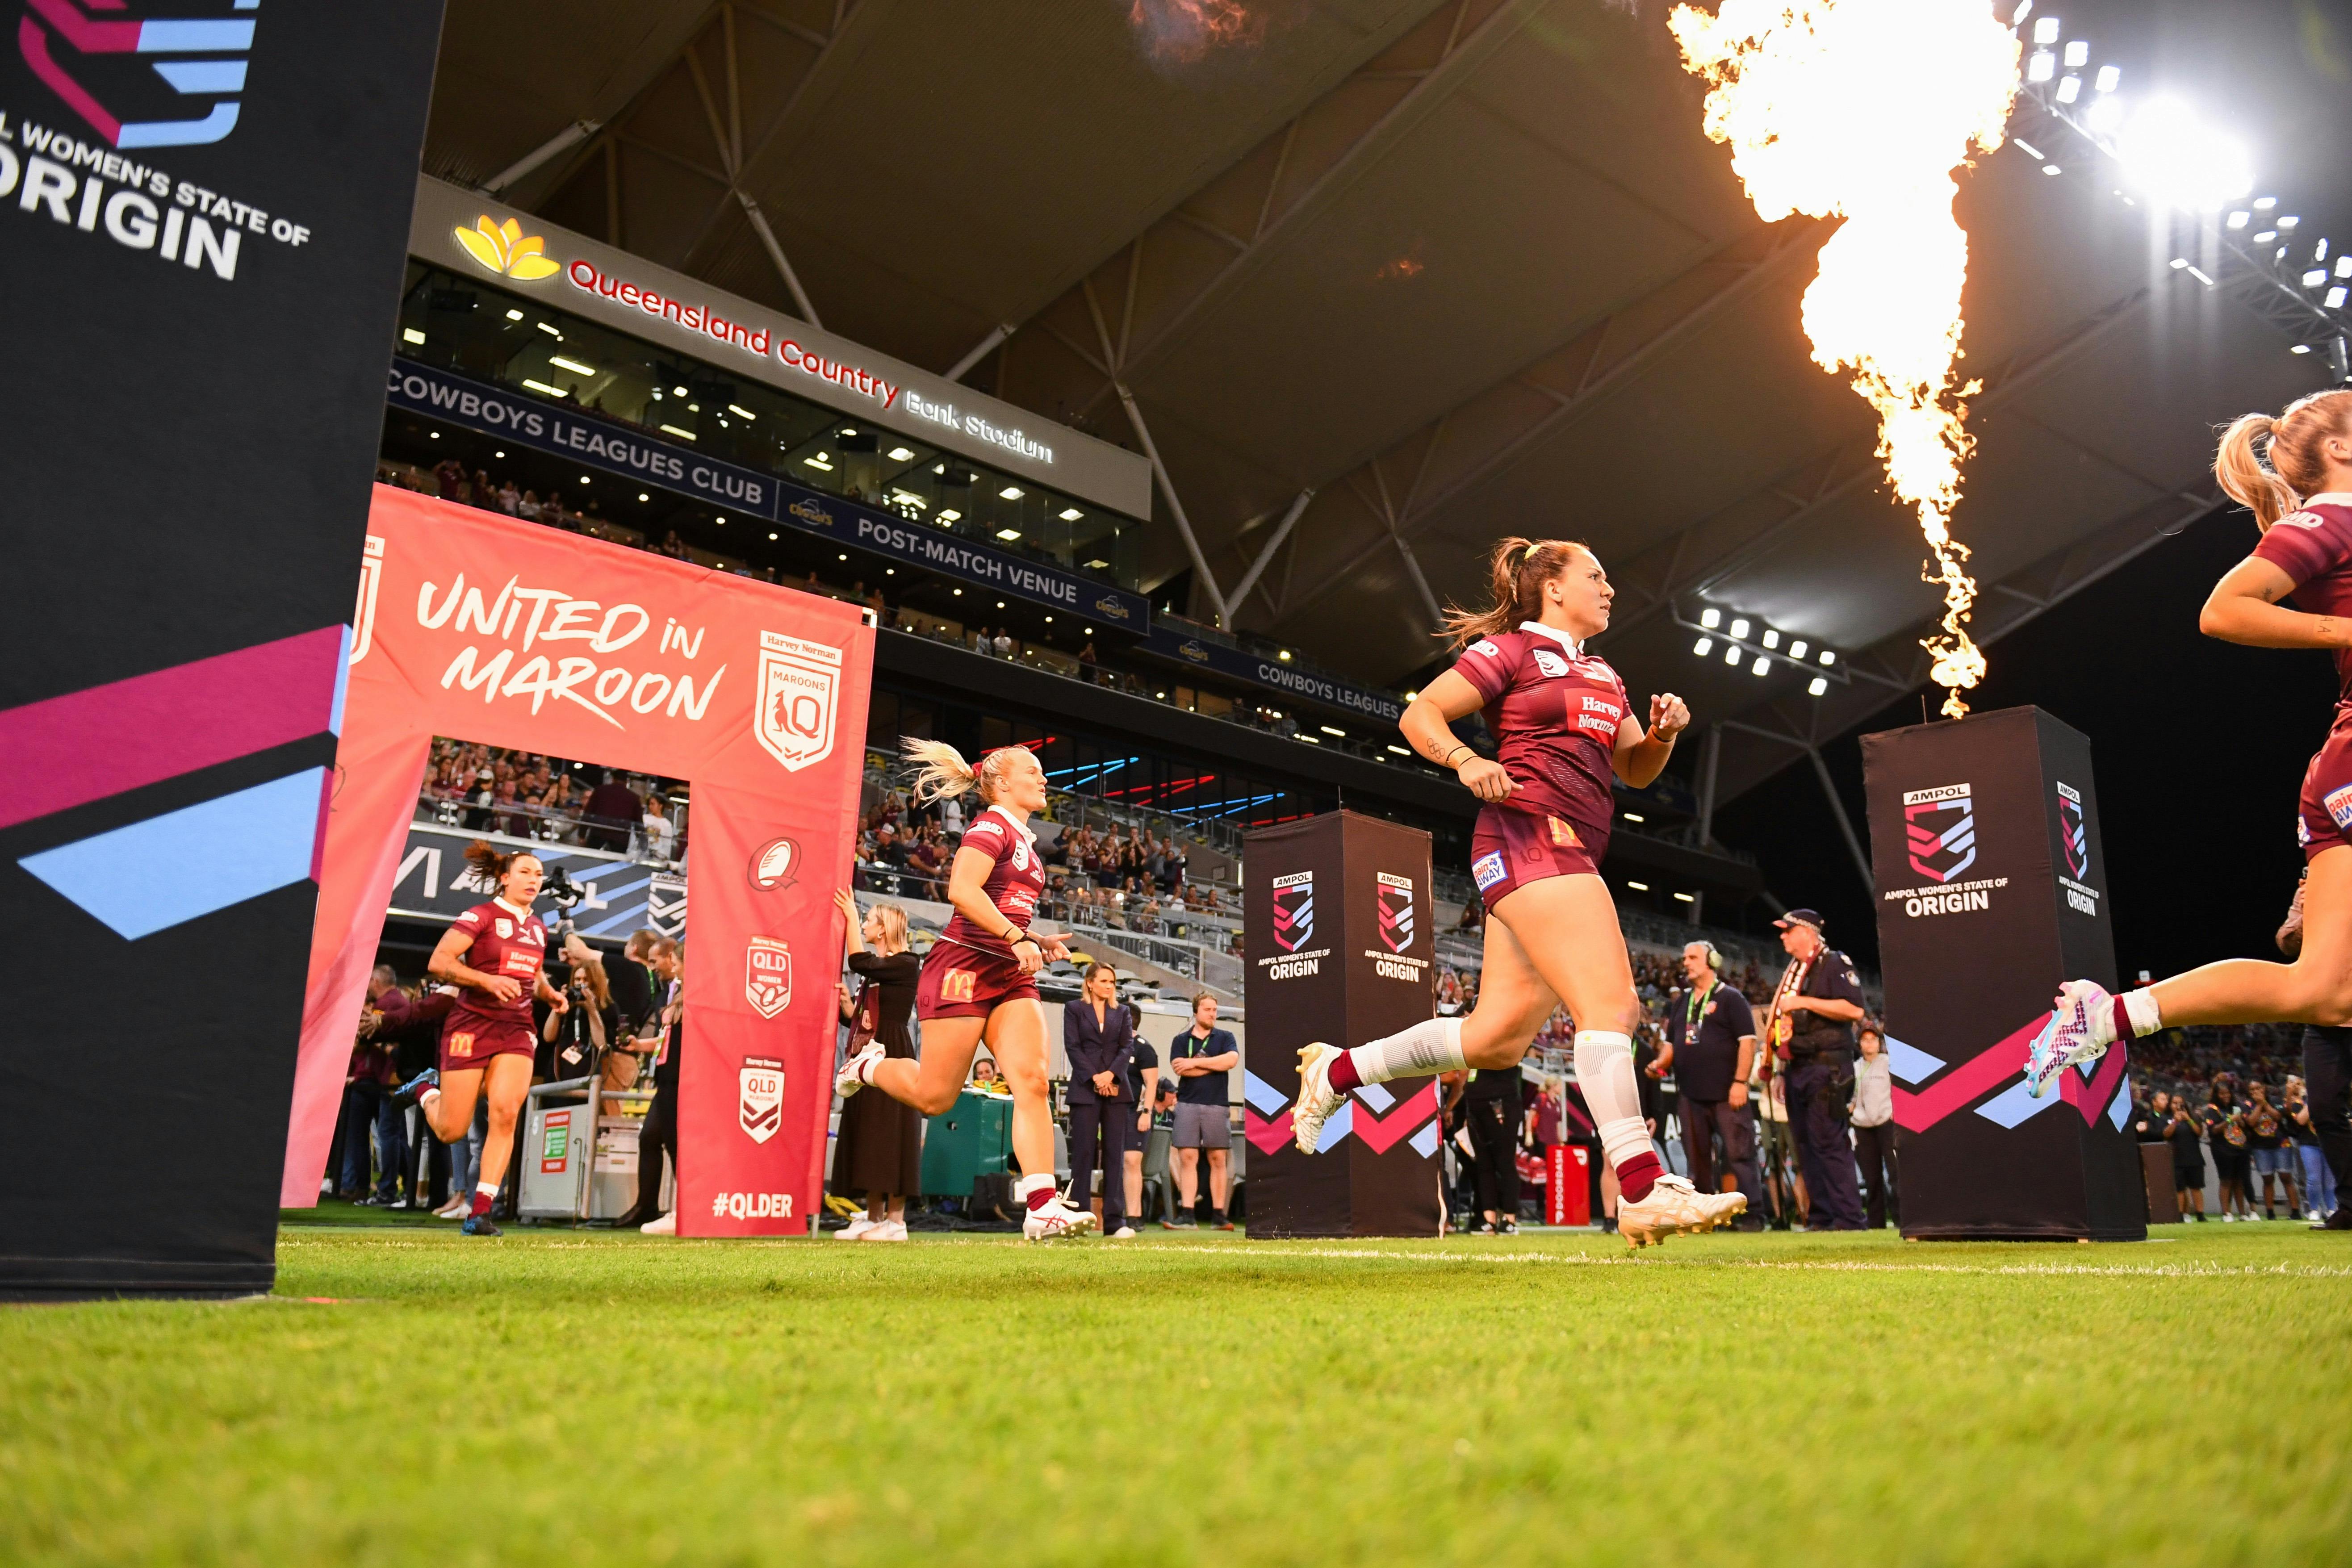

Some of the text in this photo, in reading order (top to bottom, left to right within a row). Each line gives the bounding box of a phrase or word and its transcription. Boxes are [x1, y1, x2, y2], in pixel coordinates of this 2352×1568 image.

[22, 119, 171, 197] WOMEN'S
[176, 181, 268, 234] STATE
[272, 218, 310, 247] OF
[567, 260, 1053, 464] Queensland Country Bank Stadium
[386, 369, 762, 504] COWBOYS LEAGUES CLUB
[858, 518, 1077, 603] POST-MATCH VENUE
[417, 572, 650, 654] UNITED
[767, 635, 836, 660] Harvey Norman
[440, 645, 727, 731] MAROON
[773, 670, 826, 691] MAROONS
[1259, 664, 1398, 719] COWBOYS LEAGUES
[1582, 696, 1621, 721] Harvey
[1910, 787, 1966, 802] AMPOL
[2060, 785, 2078, 801] AMPOL
[1277, 874, 1310, 886] AMPOL
[1381, 875, 1409, 887] AMPOL
[1477, 866, 1500, 888] AWAY
[1884, 878, 2008, 900] AMPOL WOMEN'S STATE OF
[1905, 890, 1989, 918] ORIGIN
[2067, 889, 2096, 917] ORIGIN
[753, 952, 787, 972] QLD
[1258, 948, 1331, 966] AMPOL WOMEN'S STATE OF
[1364, 949, 1383, 959] AMPOL
[1406, 957, 1421, 967] STATE
[757, 974, 782, 984] WOMEN
[1270, 959, 1318, 980] ORIGIN
[1376, 960, 1419, 983] ORIGIN
[748, 1078, 776, 1094] QLD
[712, 1192, 793, 1220] #QLDER
